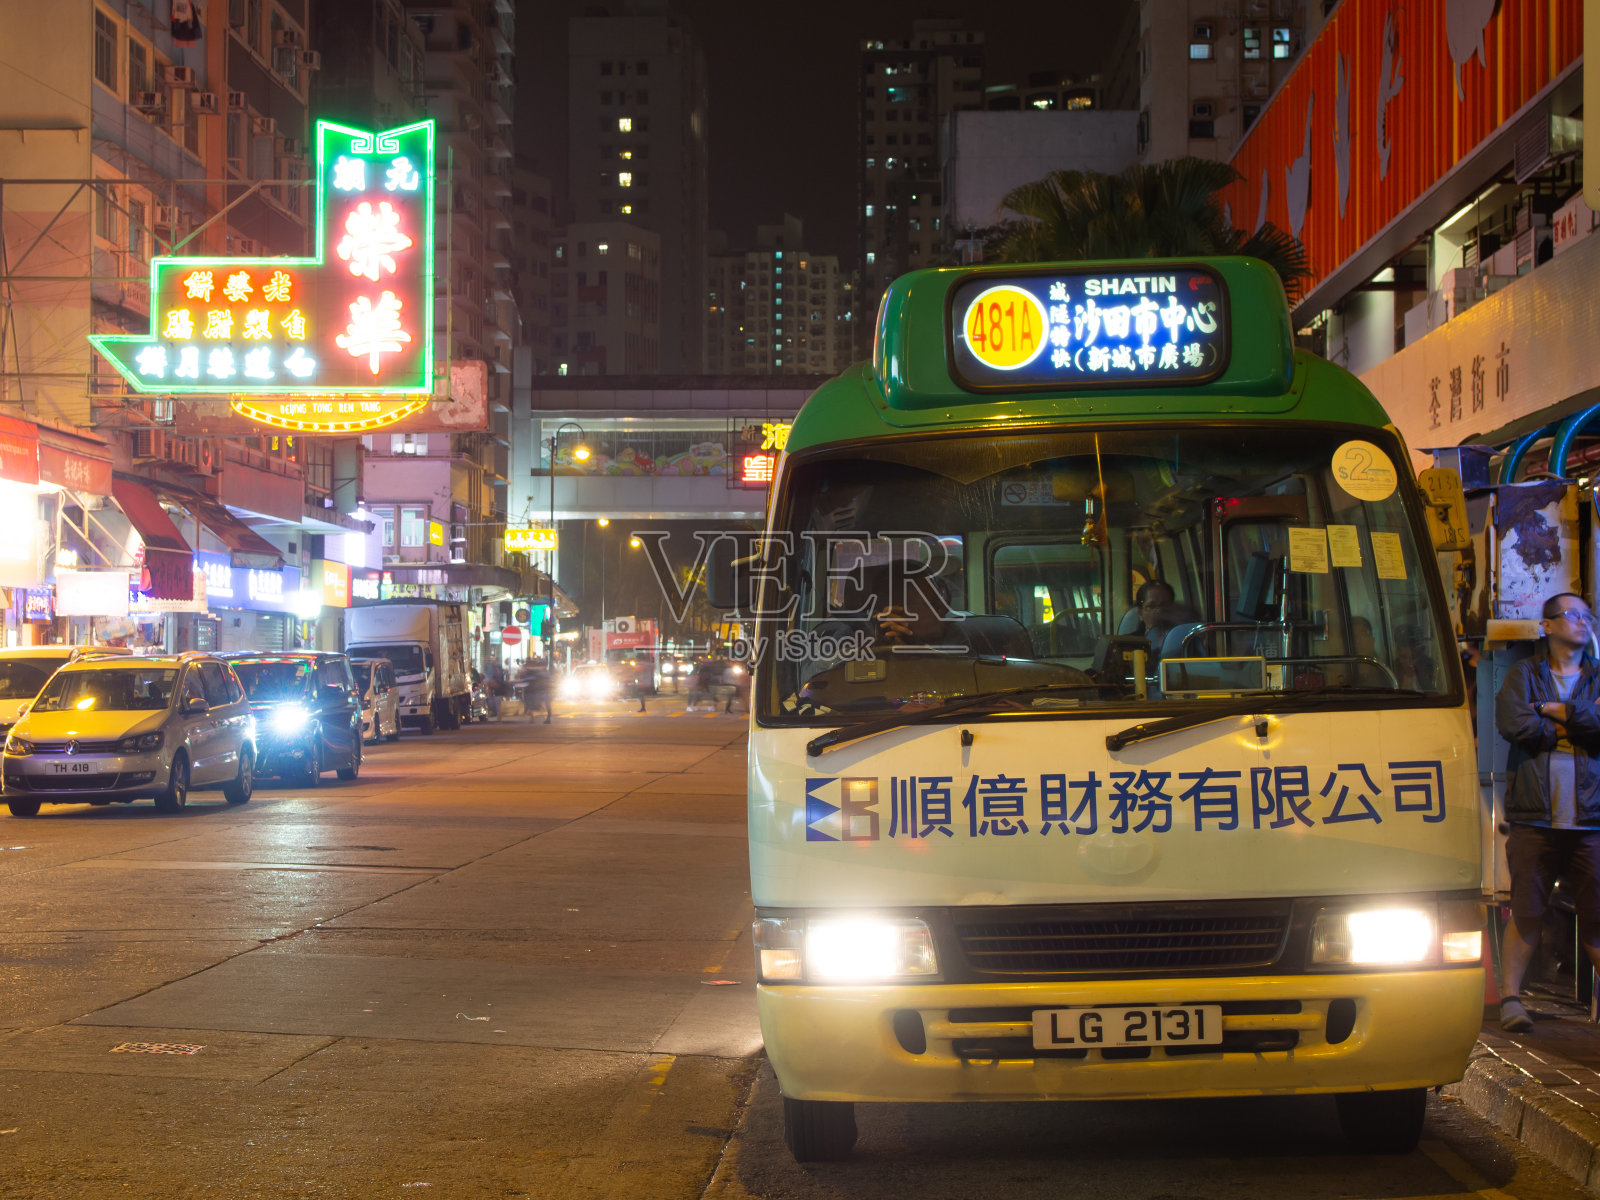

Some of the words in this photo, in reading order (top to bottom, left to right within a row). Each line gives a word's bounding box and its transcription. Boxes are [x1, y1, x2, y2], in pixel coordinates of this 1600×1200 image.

[183, 271, 292, 302] 老婆餅
[336, 201, 413, 375] 榮華
[1084, 276, 1177, 297] SHATIN
[972, 300, 1034, 353] 481A
[1074, 295, 1218, 347] 沙田市中心
[1074, 342, 1217, 373] (新城市廣場)
[1428, 341, 1510, 430] 荃灣街市
[313, 402, 333, 413] TONG
[338, 402, 354, 413] REN
[1338, 447, 1373, 480] $2
[1428, 475, 1459, 492] 2131
[53, 764, 68, 773] TH
[888, 760, 1446, 839] 順億財務有限公司
[1051, 1012, 1103, 1044] LG
[1123, 1009, 1204, 1042] 2131
